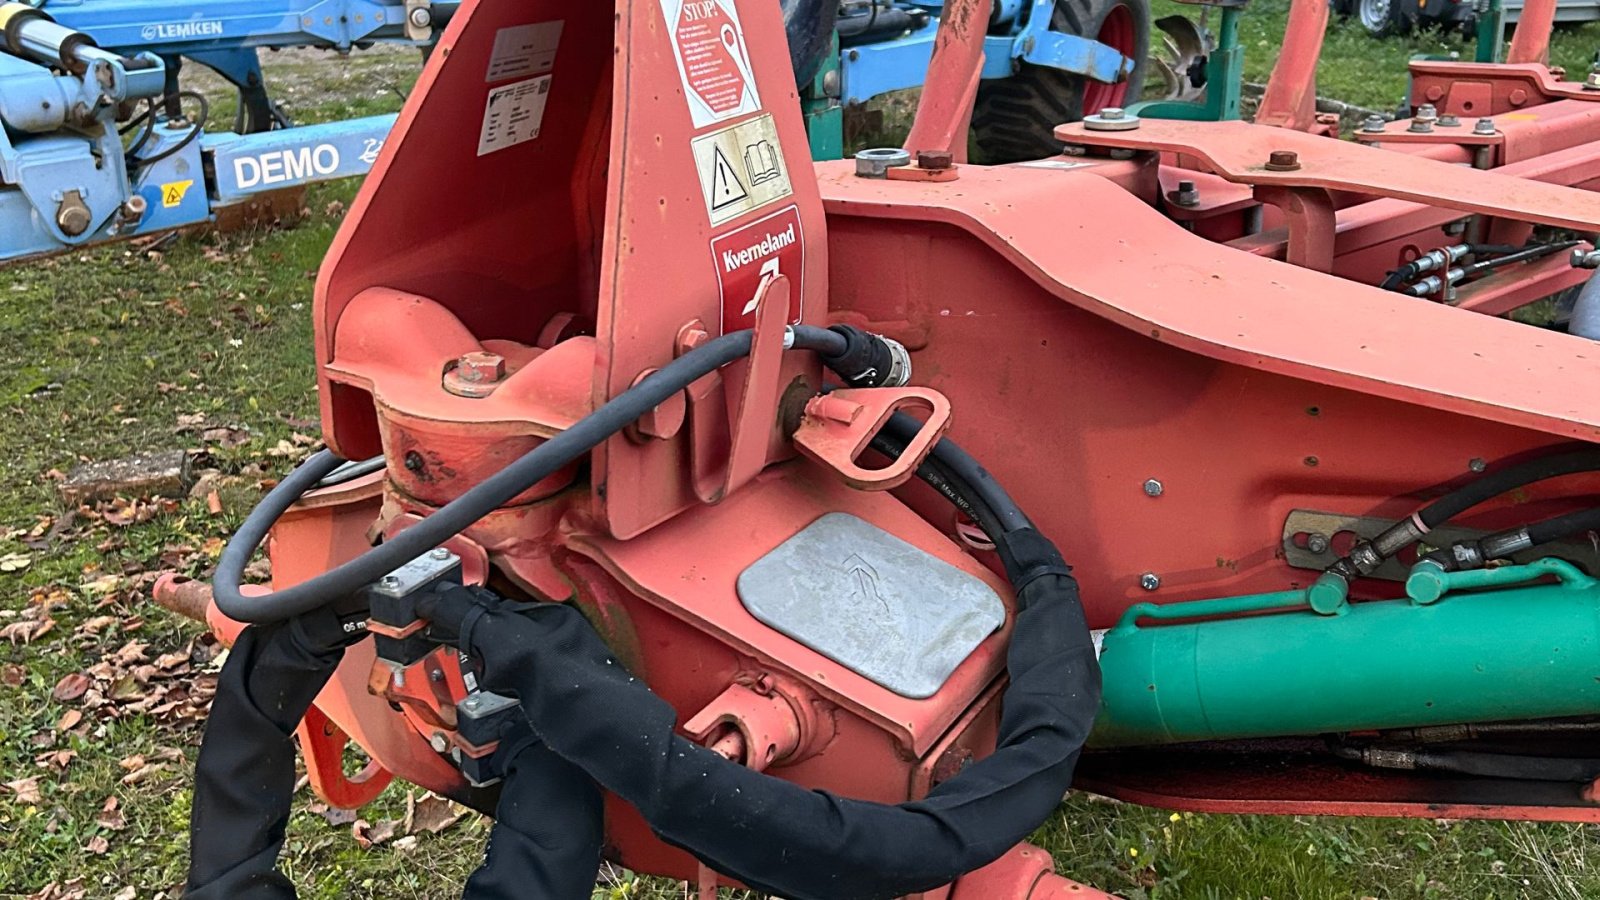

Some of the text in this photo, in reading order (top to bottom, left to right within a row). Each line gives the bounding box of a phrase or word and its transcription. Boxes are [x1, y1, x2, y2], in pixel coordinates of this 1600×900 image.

[683, 0, 718, 22] STOP!
[158, 21, 223, 38] LEMKEN
[233, 143, 340, 189] DEMO
[722, 222, 796, 273] Kverneland
[956, 496, 970, 510] WP
